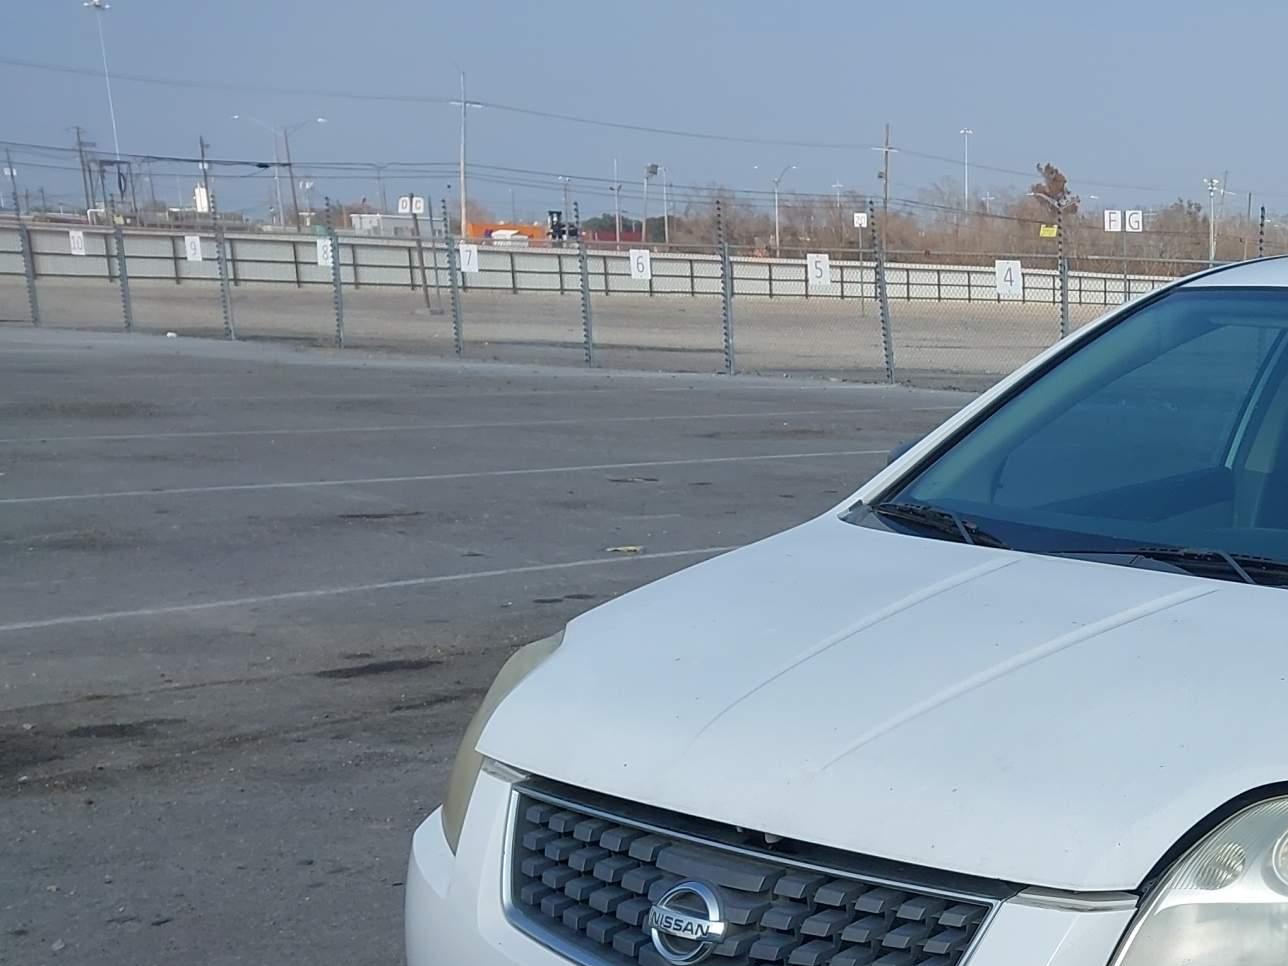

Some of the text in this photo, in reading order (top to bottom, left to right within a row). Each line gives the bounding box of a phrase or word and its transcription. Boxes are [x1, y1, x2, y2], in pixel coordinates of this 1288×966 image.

[1108, 211, 1140, 231] F G
[71, 235, 83, 250] 10
[190, 241, 197, 256] 9
[321, 244, 329, 260] 8
[464, 249, 472, 265] 7
[636, 255, 645, 273] 6
[814, 260, 823, 279] 5
[1003, 266, 1015, 287] 4
[651, 911, 710, 937] NISSAN
